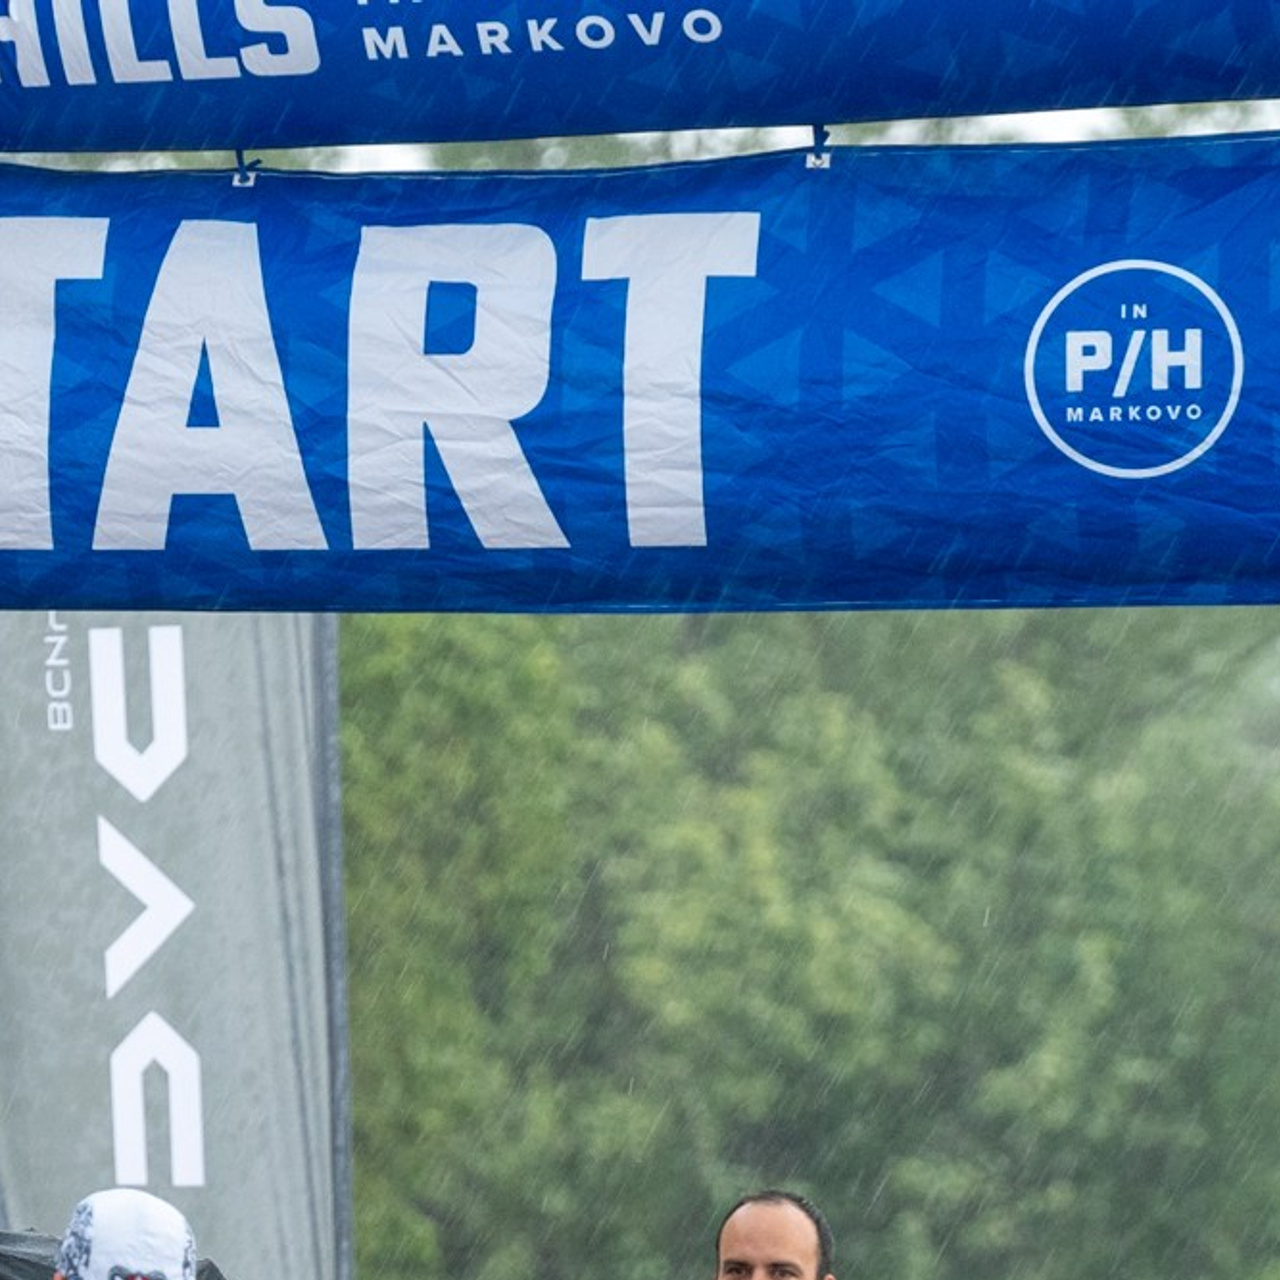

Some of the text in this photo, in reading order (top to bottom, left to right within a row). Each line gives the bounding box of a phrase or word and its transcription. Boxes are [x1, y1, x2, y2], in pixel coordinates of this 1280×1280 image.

[361, 8, 723, 61] MARKOVO
[1121, 304, 1147, 319] IN
[1066, 328, 1202, 398] P/H
[1067, 404, 1202, 422] MARKOVO
